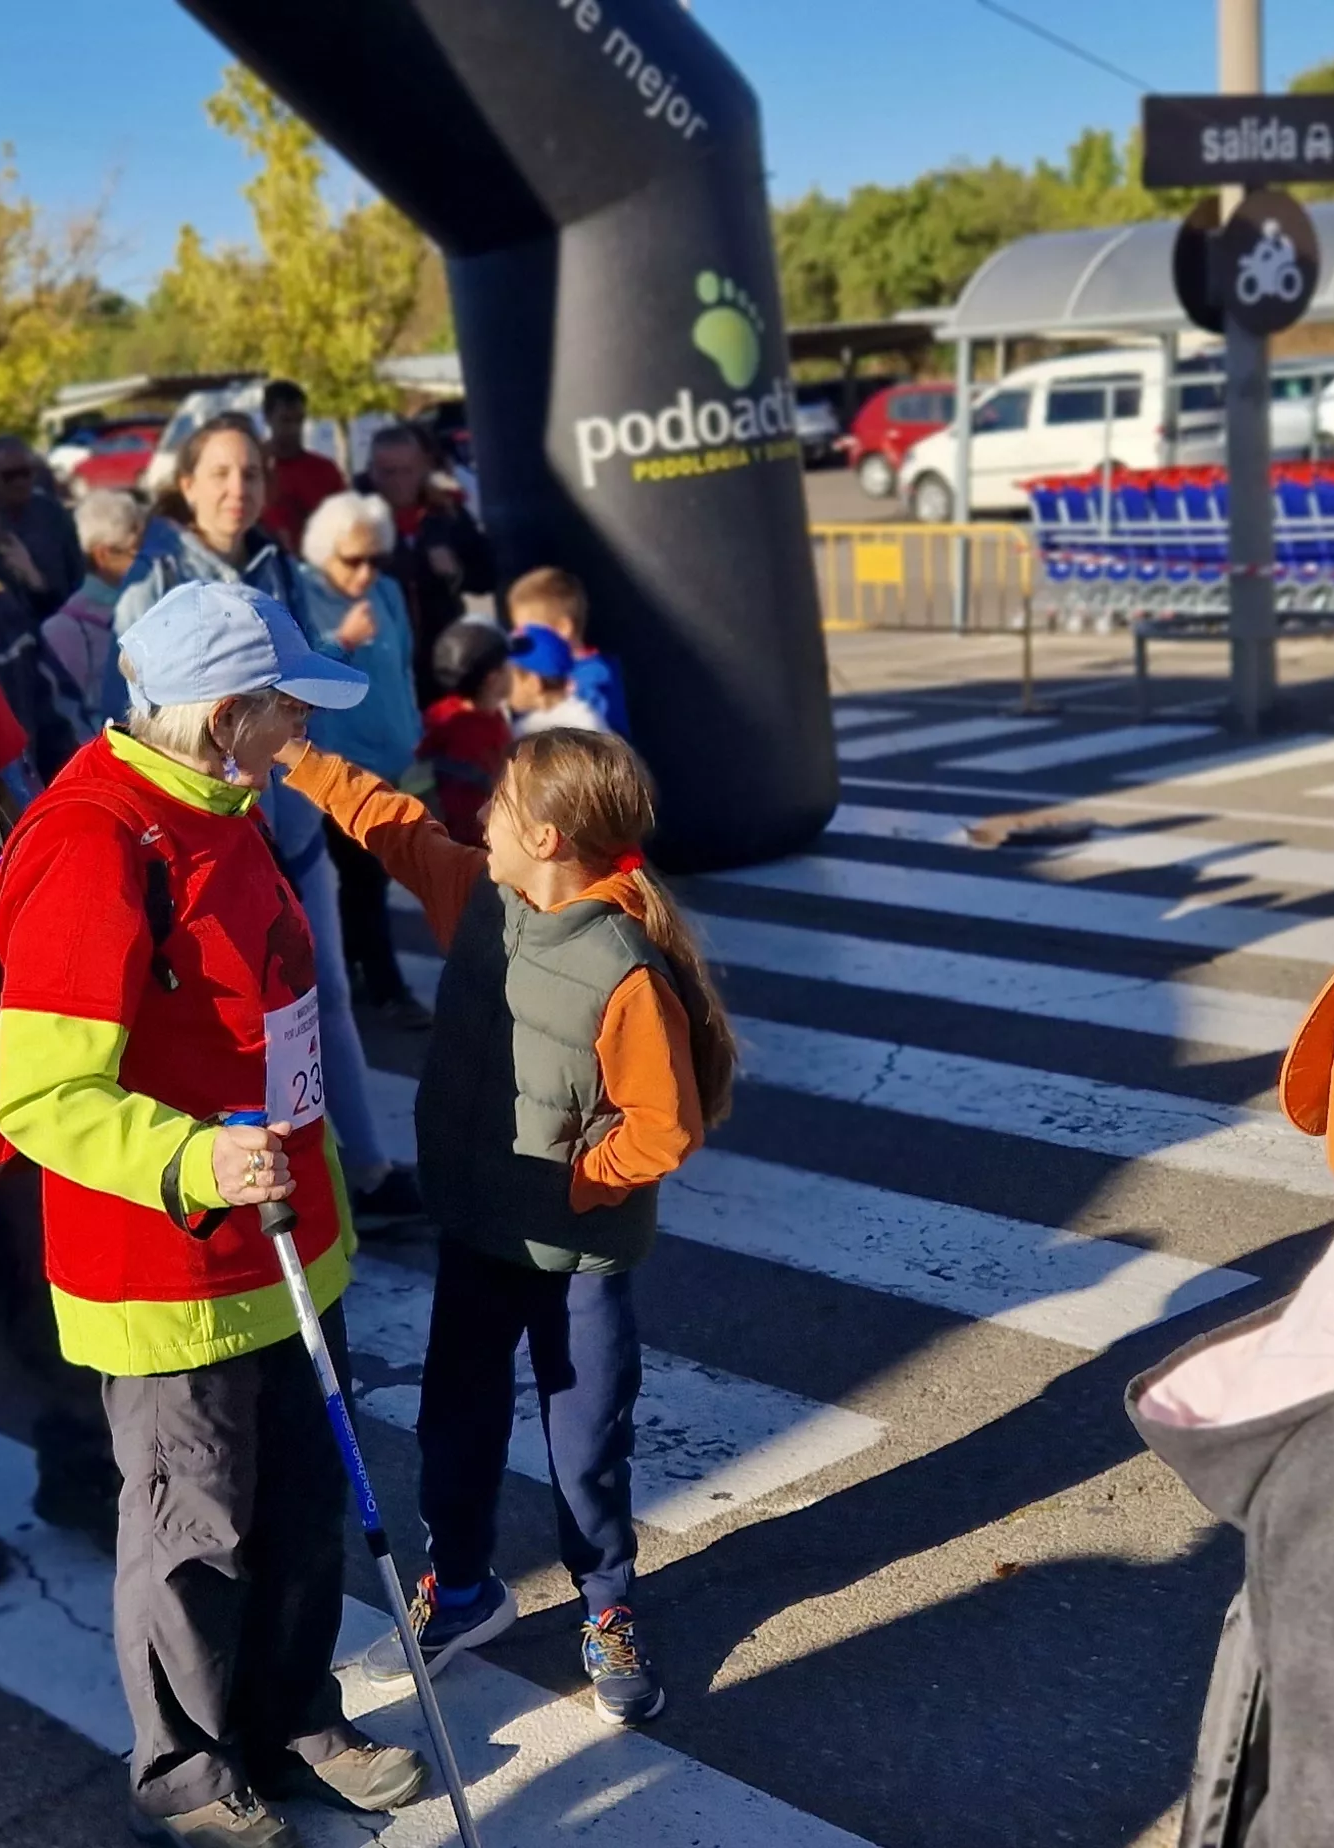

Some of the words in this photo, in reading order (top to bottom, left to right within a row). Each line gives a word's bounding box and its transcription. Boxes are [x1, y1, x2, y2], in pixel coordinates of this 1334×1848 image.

[602, 26, 708, 140] mejor
[1201, 115, 1297, 163] salida
[292, 1062, 322, 1116] 23
[351, 1446, 377, 1514] Quechua
